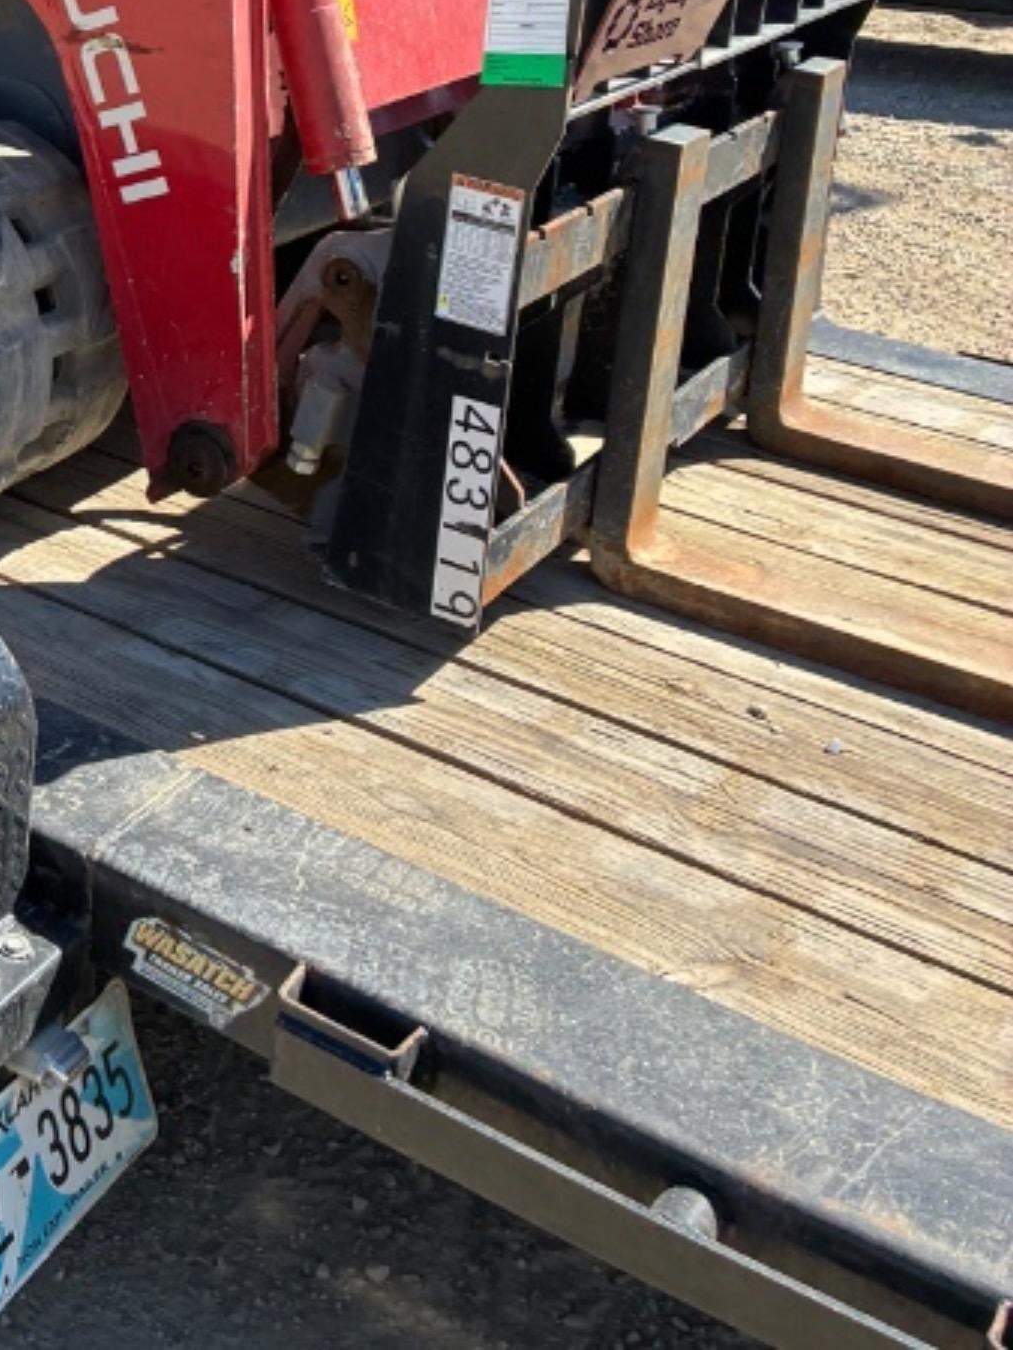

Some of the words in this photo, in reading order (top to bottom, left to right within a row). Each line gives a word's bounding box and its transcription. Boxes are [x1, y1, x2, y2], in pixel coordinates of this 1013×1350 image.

[626, 17, 681, 48] Share
[434, 404, 495, 620] 483119
[135, 921, 256, 1002] WASATCH
